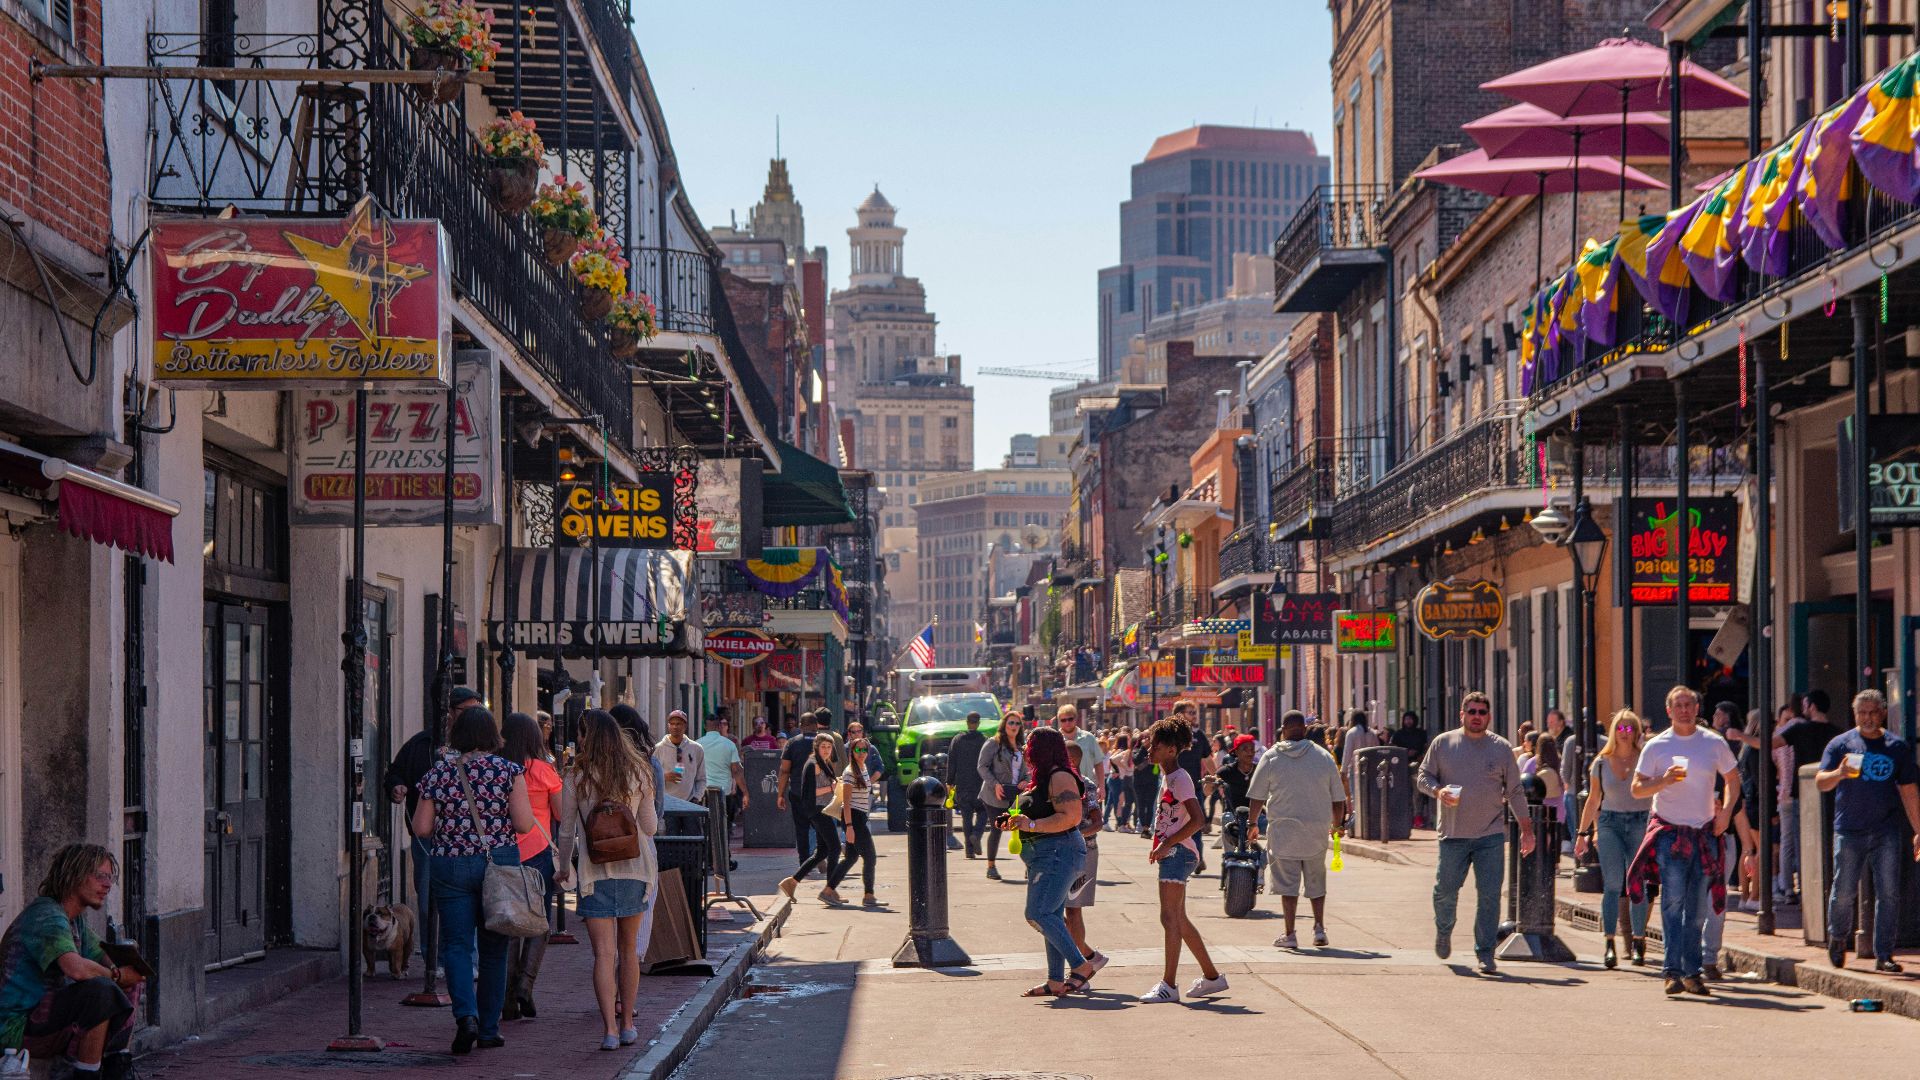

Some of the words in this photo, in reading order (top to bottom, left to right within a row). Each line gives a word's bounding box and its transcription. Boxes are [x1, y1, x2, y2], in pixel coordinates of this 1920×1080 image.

[177, 228, 275, 291] Big
[162, 286, 350, 348] Daddy's
[165, 345, 321, 373] Bottomless
[327, 343, 434, 377] Topless
[335, 449, 447, 469] EPRESS
[390, 477, 423, 497] THE
[428, 477, 475, 497] SLCE
[570, 487, 661, 511] CRIS
[562, 514, 668, 538] OWENS
[1632, 527, 1669, 558] BIG
[1263, 611, 1334, 623] SUTR
[1424, 602, 1500, 620] BANDSTAND
[583, 621, 675, 645] OWENS
[704, 638, 775, 652] DIXIELAND
[1244, 665, 1265, 683] CLUB
